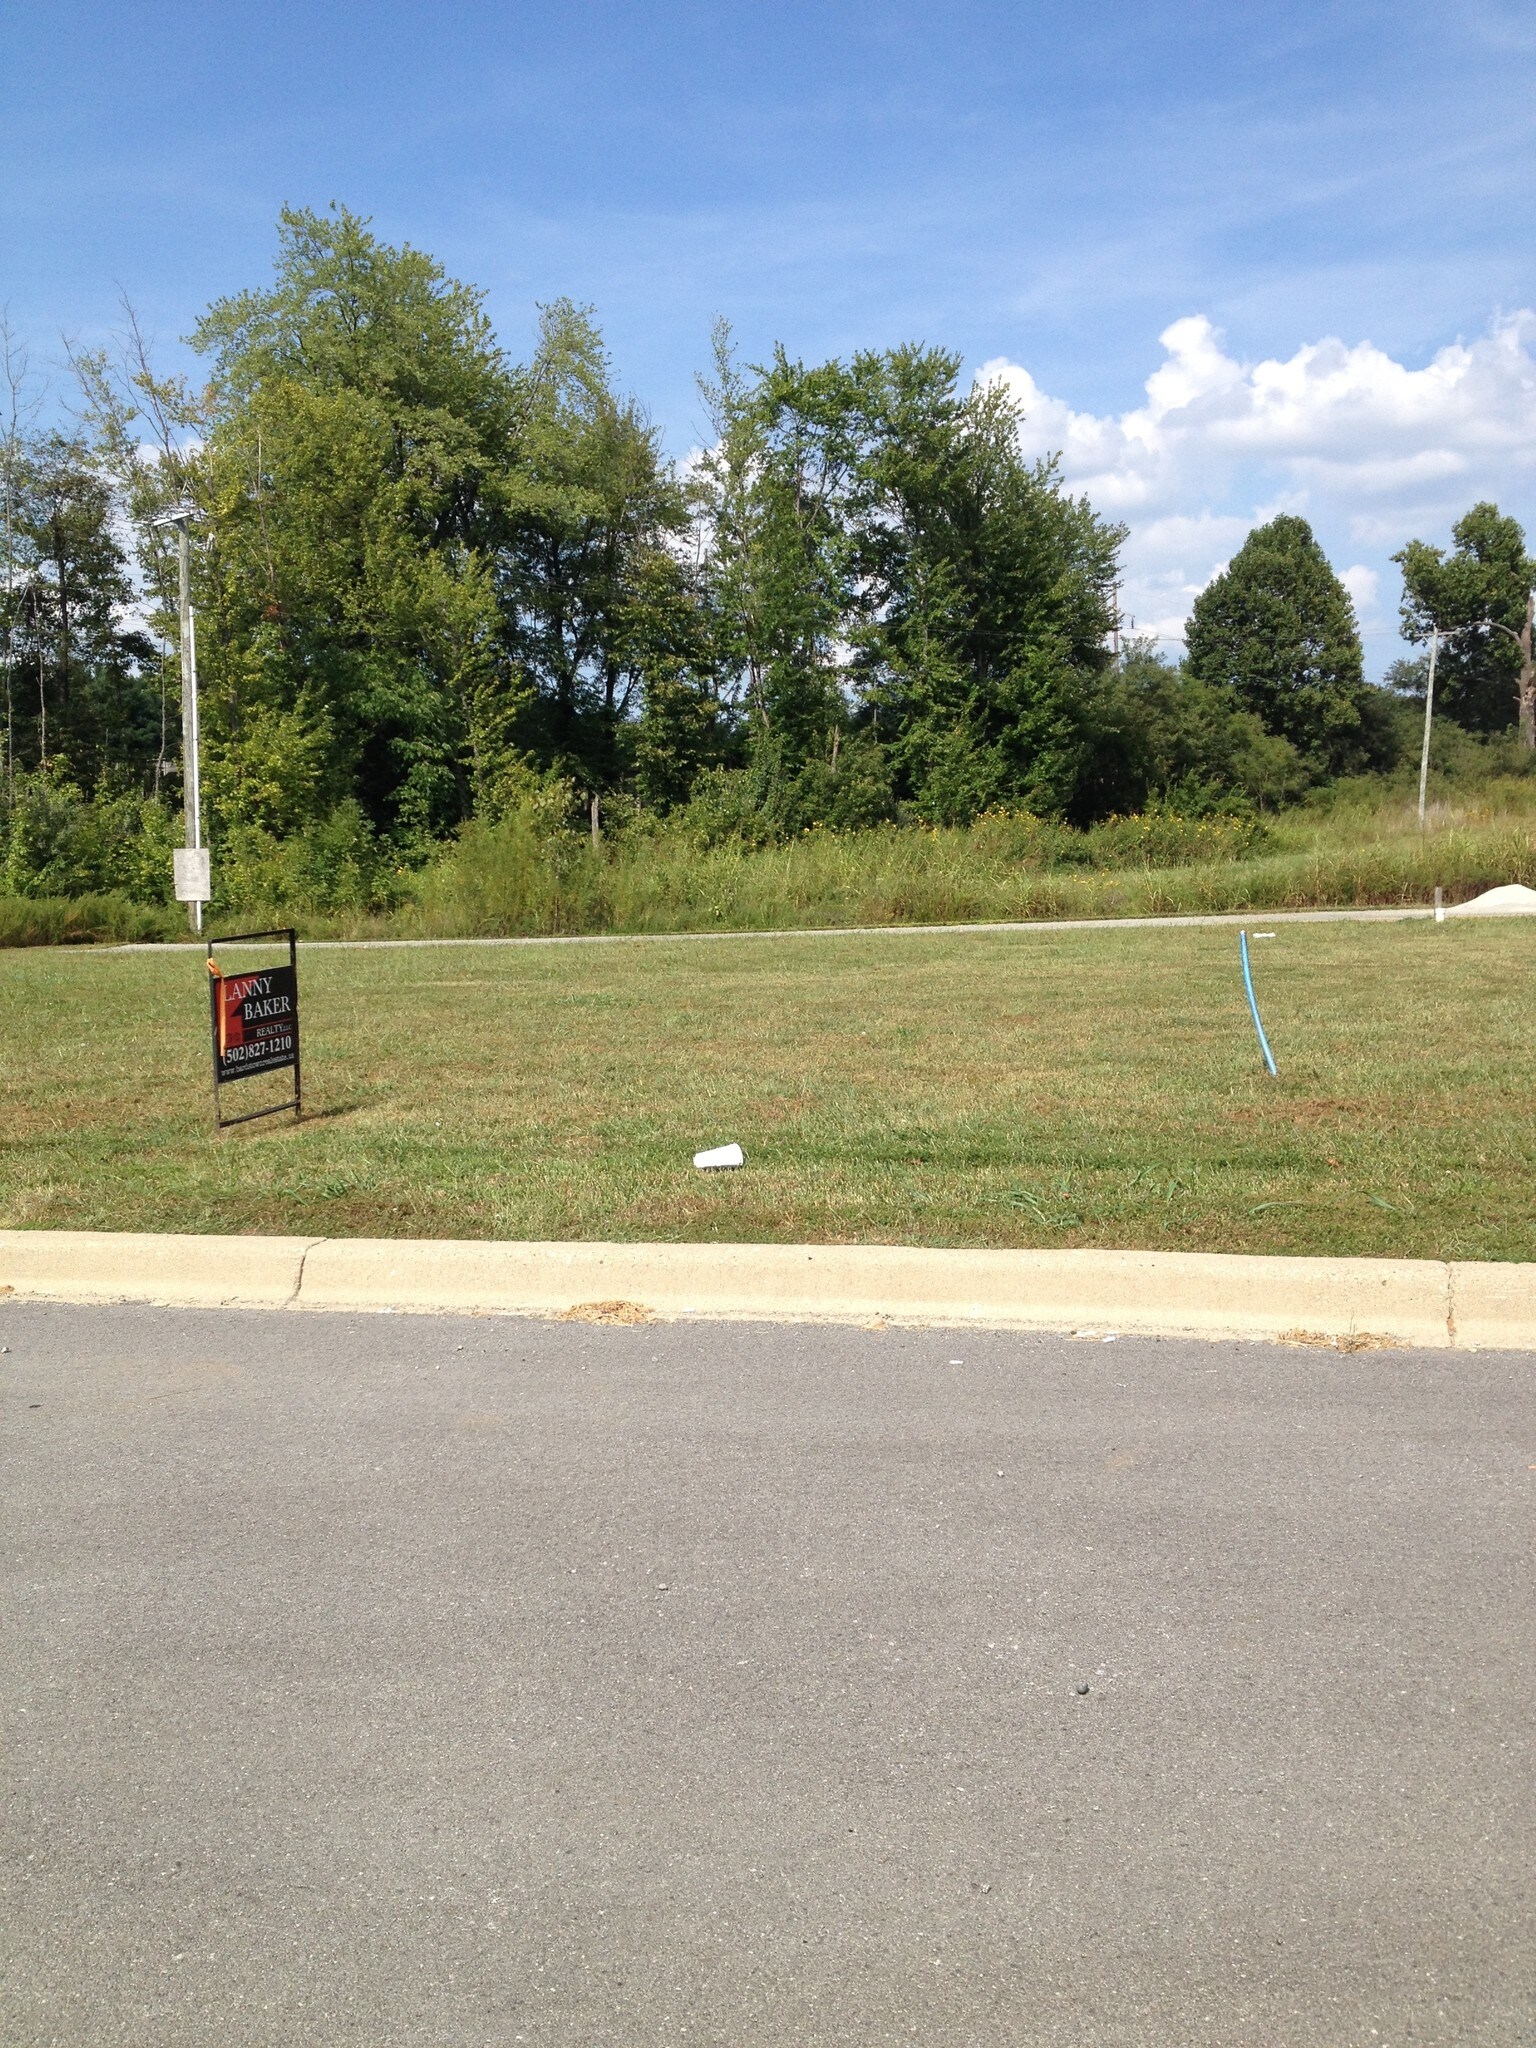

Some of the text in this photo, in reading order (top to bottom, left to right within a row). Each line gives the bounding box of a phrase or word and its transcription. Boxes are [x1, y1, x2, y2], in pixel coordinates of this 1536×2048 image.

[224, 976, 273, 1001] LANNY
[244, 996, 291, 1020] BAKER
[256, 1024, 283, 1037] REALTY
[223, 1035, 292, 1066] (502)827-1210
